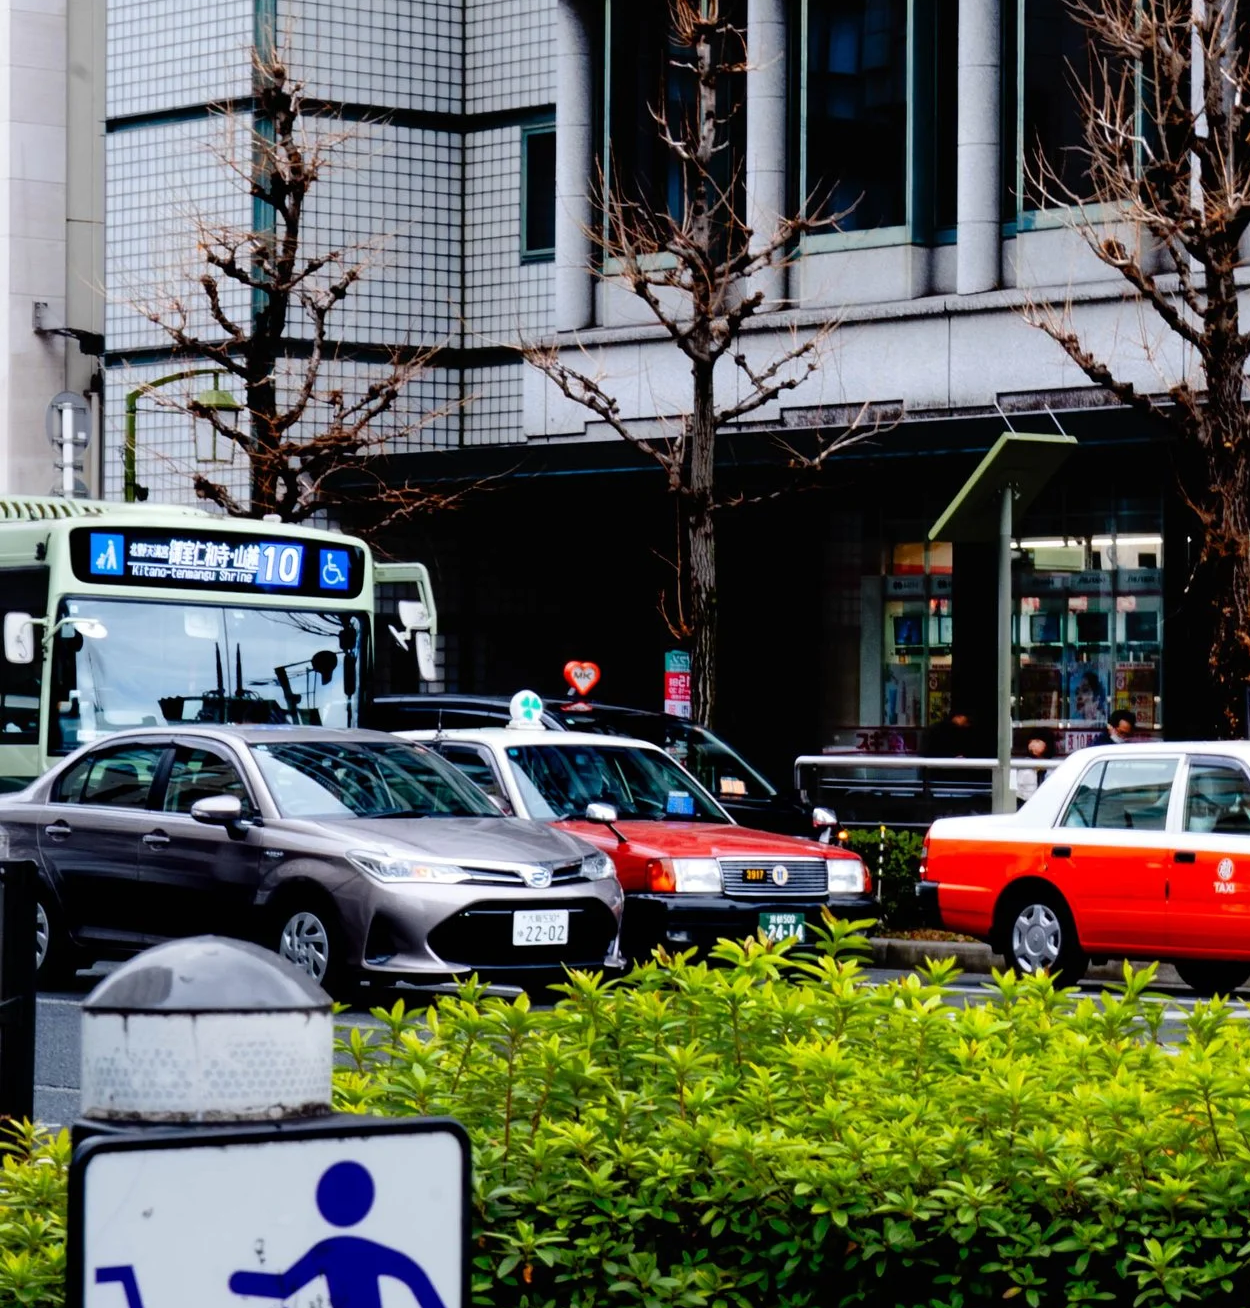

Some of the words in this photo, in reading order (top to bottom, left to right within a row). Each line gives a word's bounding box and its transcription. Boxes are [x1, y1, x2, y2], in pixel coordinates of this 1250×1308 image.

[263, 546, 299, 583] 10
[132, 565, 215, 581] Kitano-tenmangu
[219, 571, 253, 583] Shrine
[746, 869, 764, 880] 3917
[1214, 881, 1235, 894] TAXI
